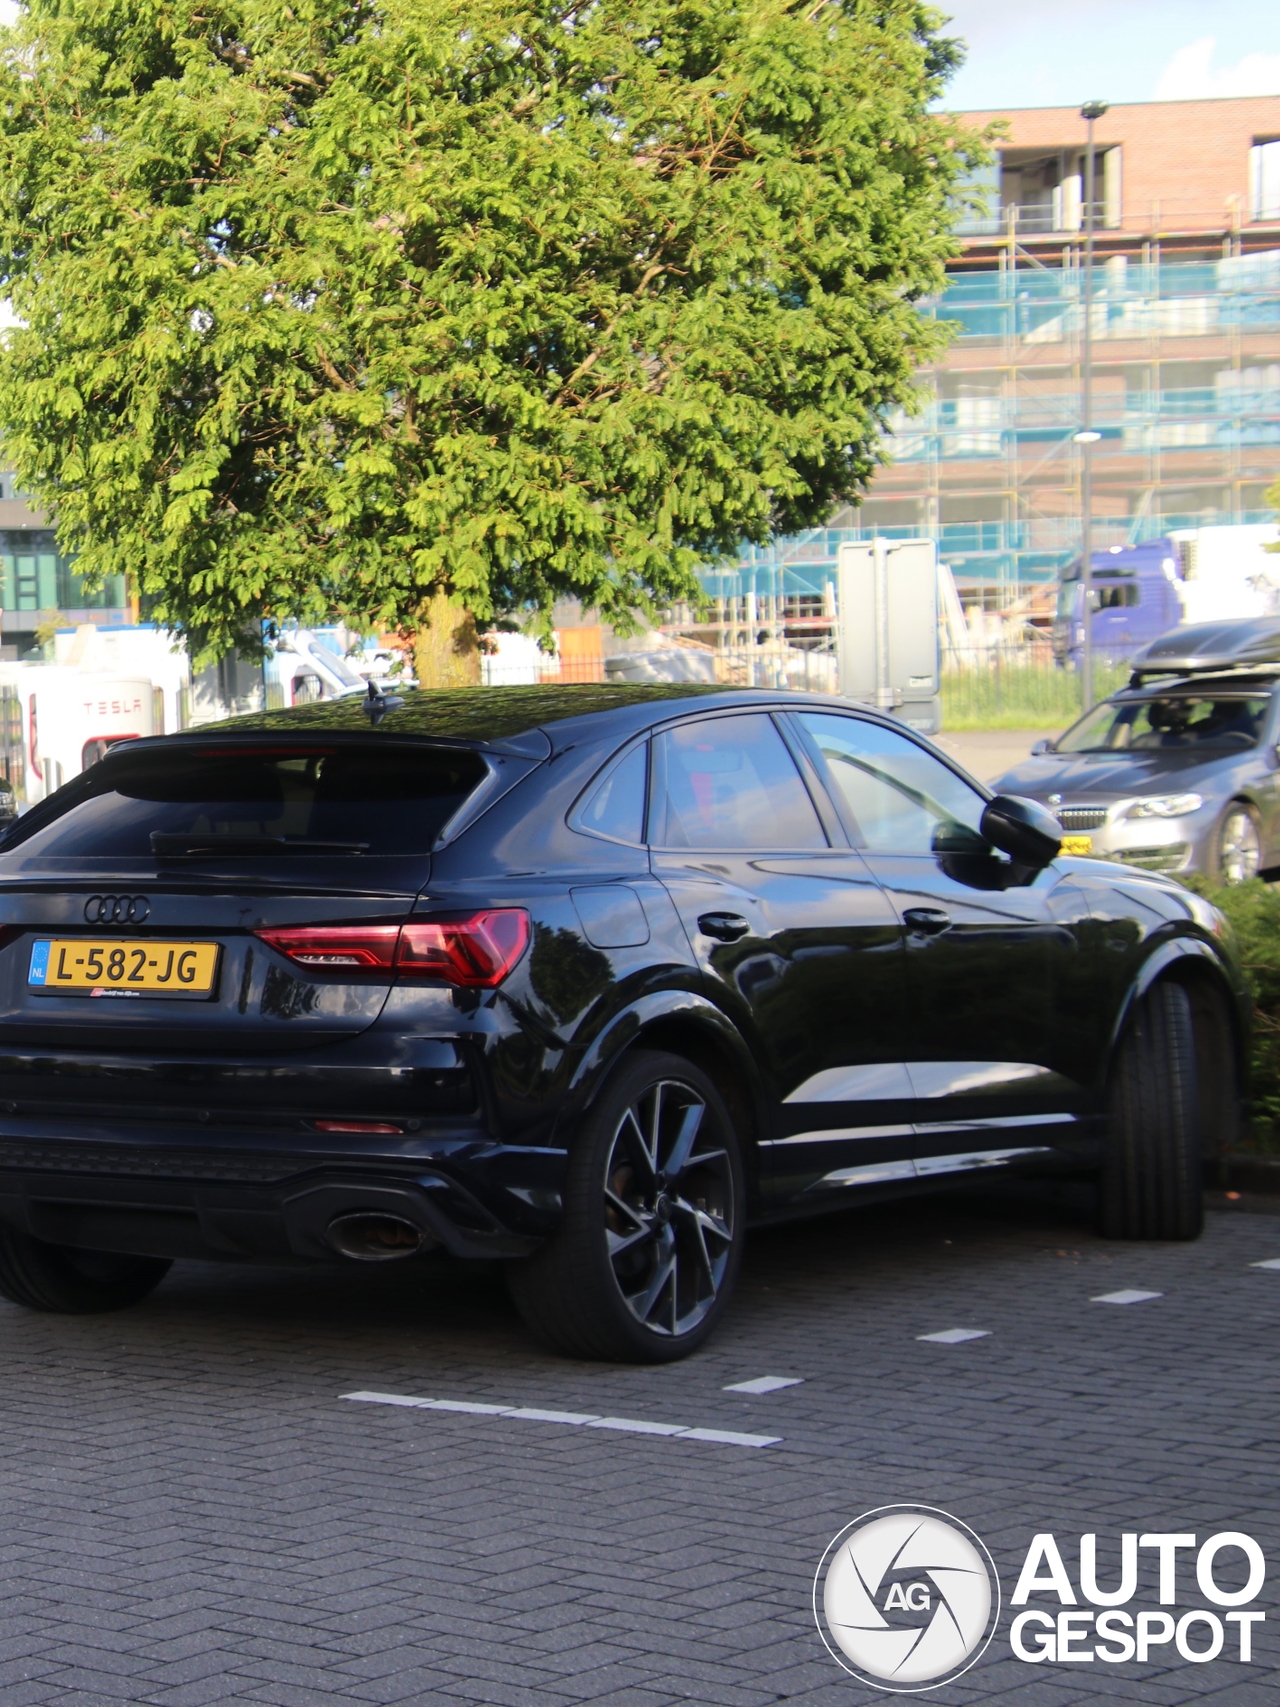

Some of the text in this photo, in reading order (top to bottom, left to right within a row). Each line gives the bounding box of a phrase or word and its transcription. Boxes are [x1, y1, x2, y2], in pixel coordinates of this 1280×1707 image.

[83, 699, 141, 715] TESLA
[32, 967, 45, 978] NL
[56, 948, 198, 983] L-582-JG
